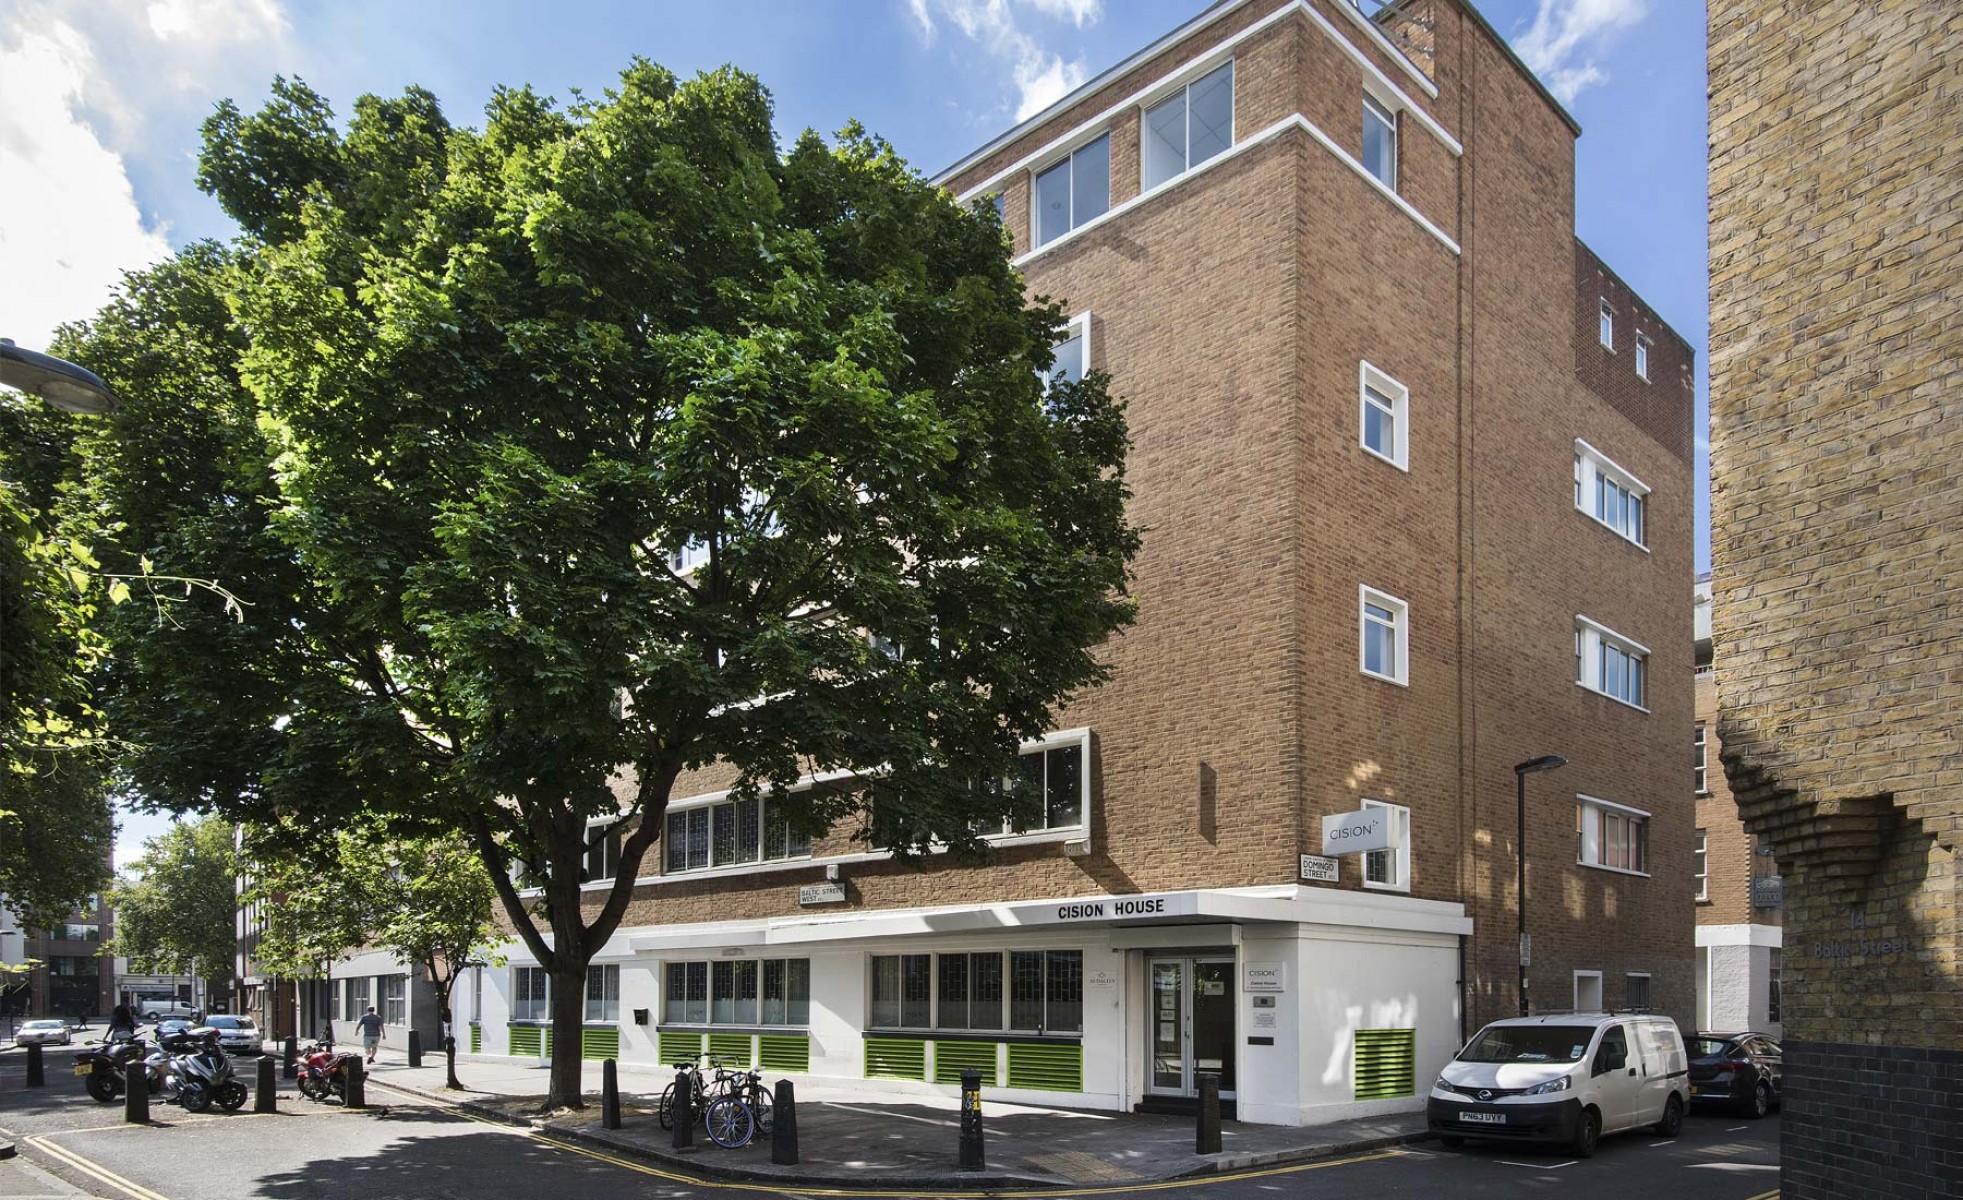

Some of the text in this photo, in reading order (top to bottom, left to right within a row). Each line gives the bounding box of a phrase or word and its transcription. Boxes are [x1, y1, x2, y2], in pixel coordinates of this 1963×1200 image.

[1329, 824, 1372, 840] CISION
[1303, 860, 1335, 872] DOMINGO
[1303, 869, 1328, 879] STREET
[801, 887, 843, 897] BALTIC STREET
[801, 895, 817, 903] WEST
[1058, 899, 1164, 919] CISION HOUSE
[1815, 937, 1909, 958] Baltic Street
[1249, 969, 1276, 977] CISION
[1462, 1112, 1484, 1121] PN63
